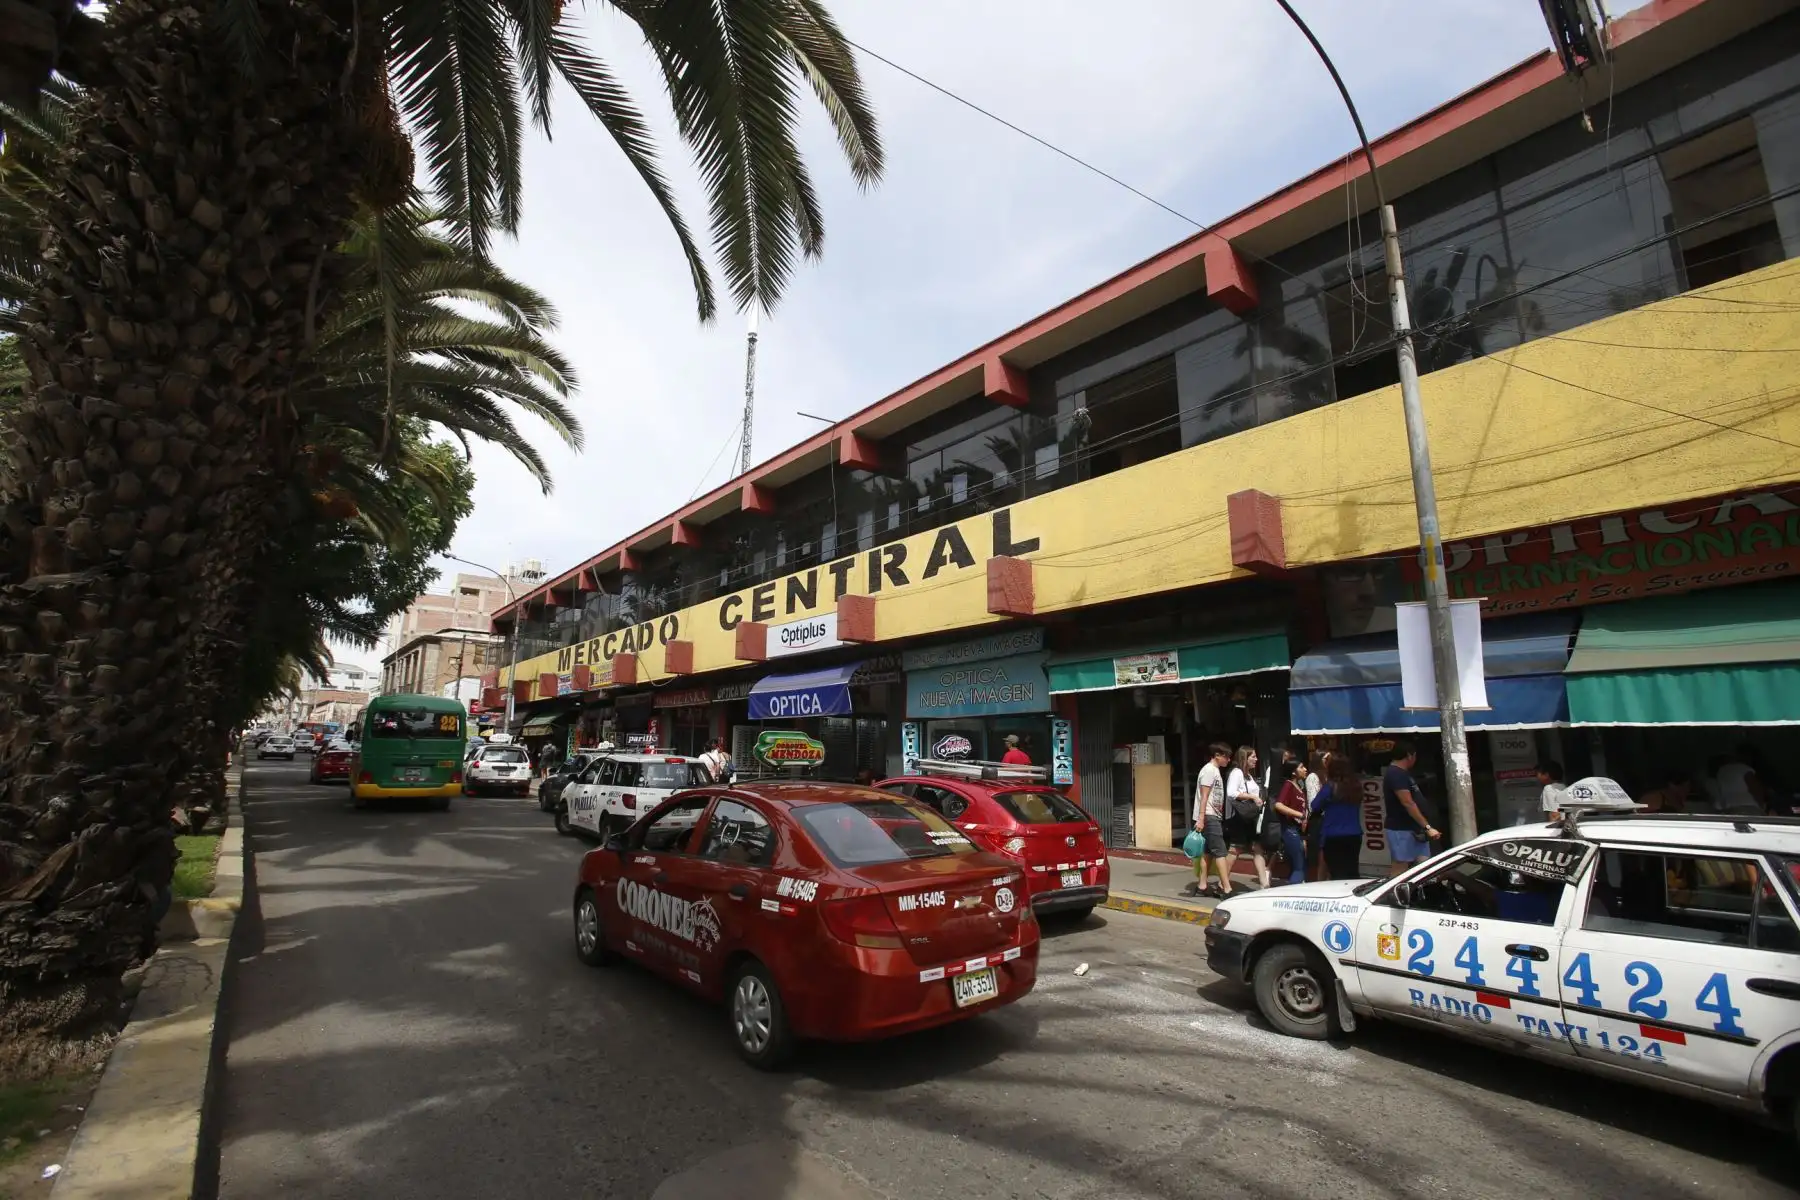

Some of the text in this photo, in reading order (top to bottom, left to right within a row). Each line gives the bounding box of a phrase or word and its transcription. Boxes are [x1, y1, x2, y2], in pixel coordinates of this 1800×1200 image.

[558, 508, 1040, 672] MERCADO CENTRAL
[781, 621, 826, 646] Optiplus
[989, 632, 1040, 651] IMAGEN
[940, 666, 1008, 687] OPTICA
[770, 692, 822, 716] OPTICA
[919, 683, 1034, 708] NUEVA IMAGEN
[440, 715, 457, 731] 22
[771, 750, 822, 759] MENDOZA
[1055, 721, 1068, 768] OPTICA
[1497, 740, 1527, 749] TODO
[1573, 787, 1592, 799] 02
[1363, 781, 1385, 851] CAMBIO
[1502, 842, 1580, 866] OPALU
[1520, 860, 1566, 874] LINTERNAS
[776, 877, 819, 902] MM-15405
[898, 890, 946, 912] MM-15405
[617, 877, 695, 942] CORONEL
[1271, 899, 1359, 914] www.radiotaxi124.com
[1438, 918, 1480, 931] Z3P-483
[956, 974, 993, 1000] Z4R-351
[1408, 988, 1492, 1024] RADIO
[1517, 1014, 1667, 1064] TAXI 124
